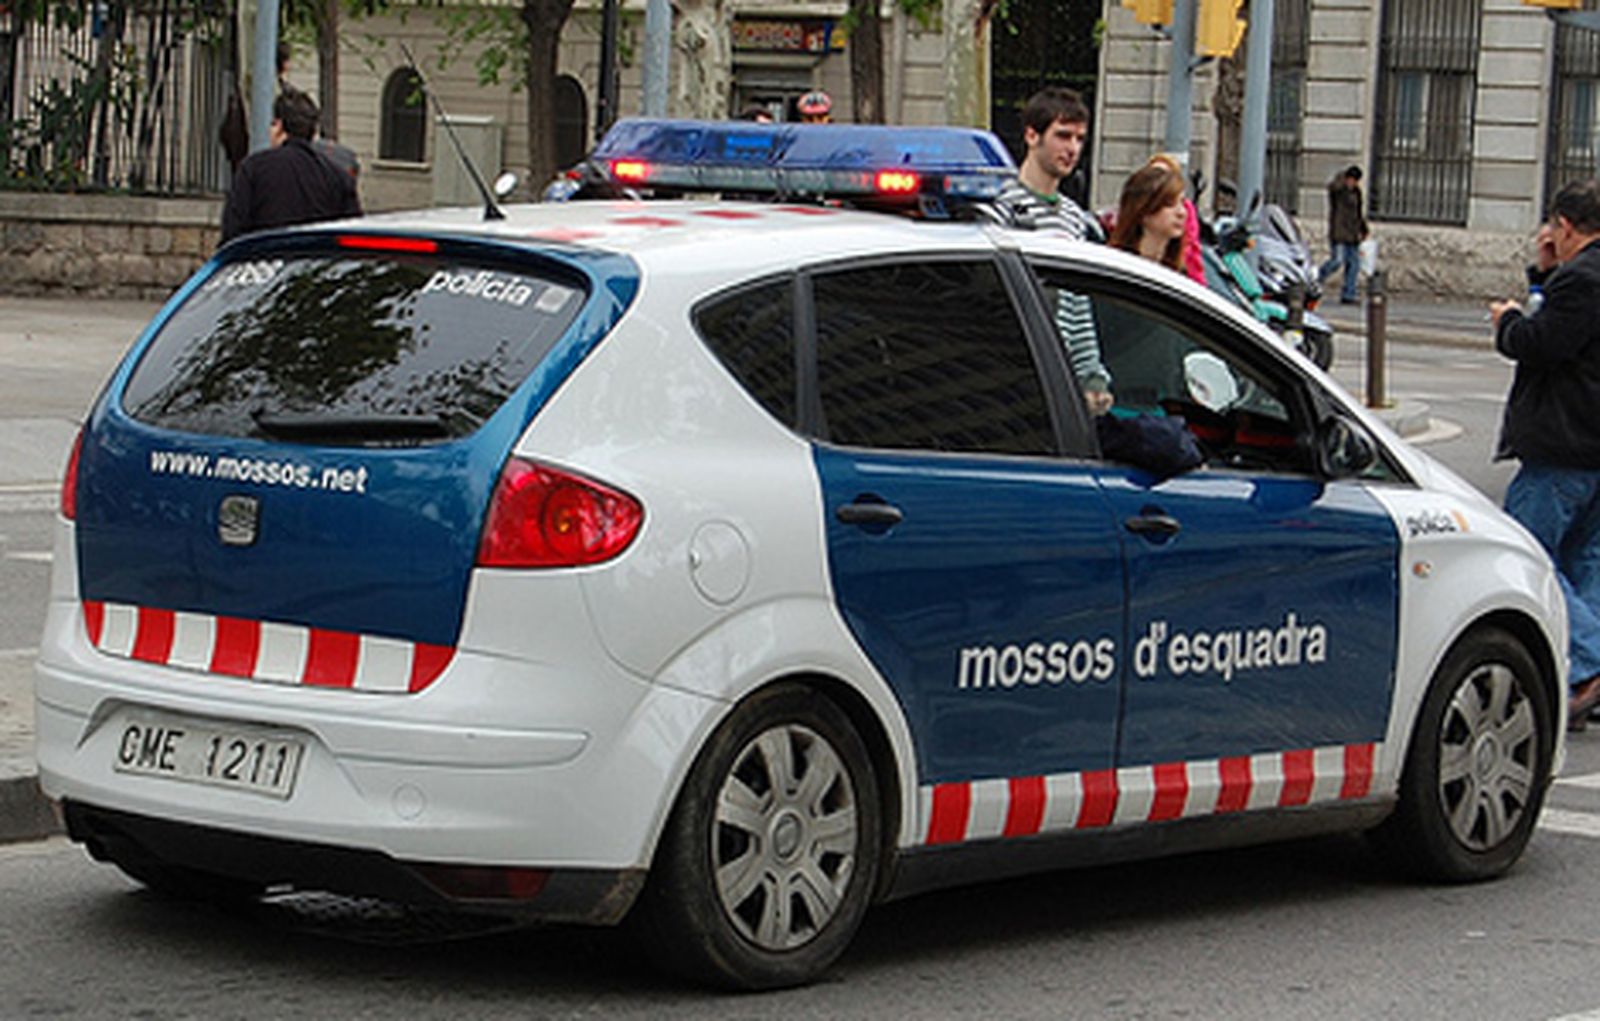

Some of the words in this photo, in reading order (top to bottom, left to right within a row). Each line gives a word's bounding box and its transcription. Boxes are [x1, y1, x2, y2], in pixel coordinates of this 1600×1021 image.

[151, 451, 368, 493] www.mossos.net
[958, 637, 1115, 688] mossos
[1134, 612, 1327, 682] d'esquadra
[206, 736, 288, 786] 1211
